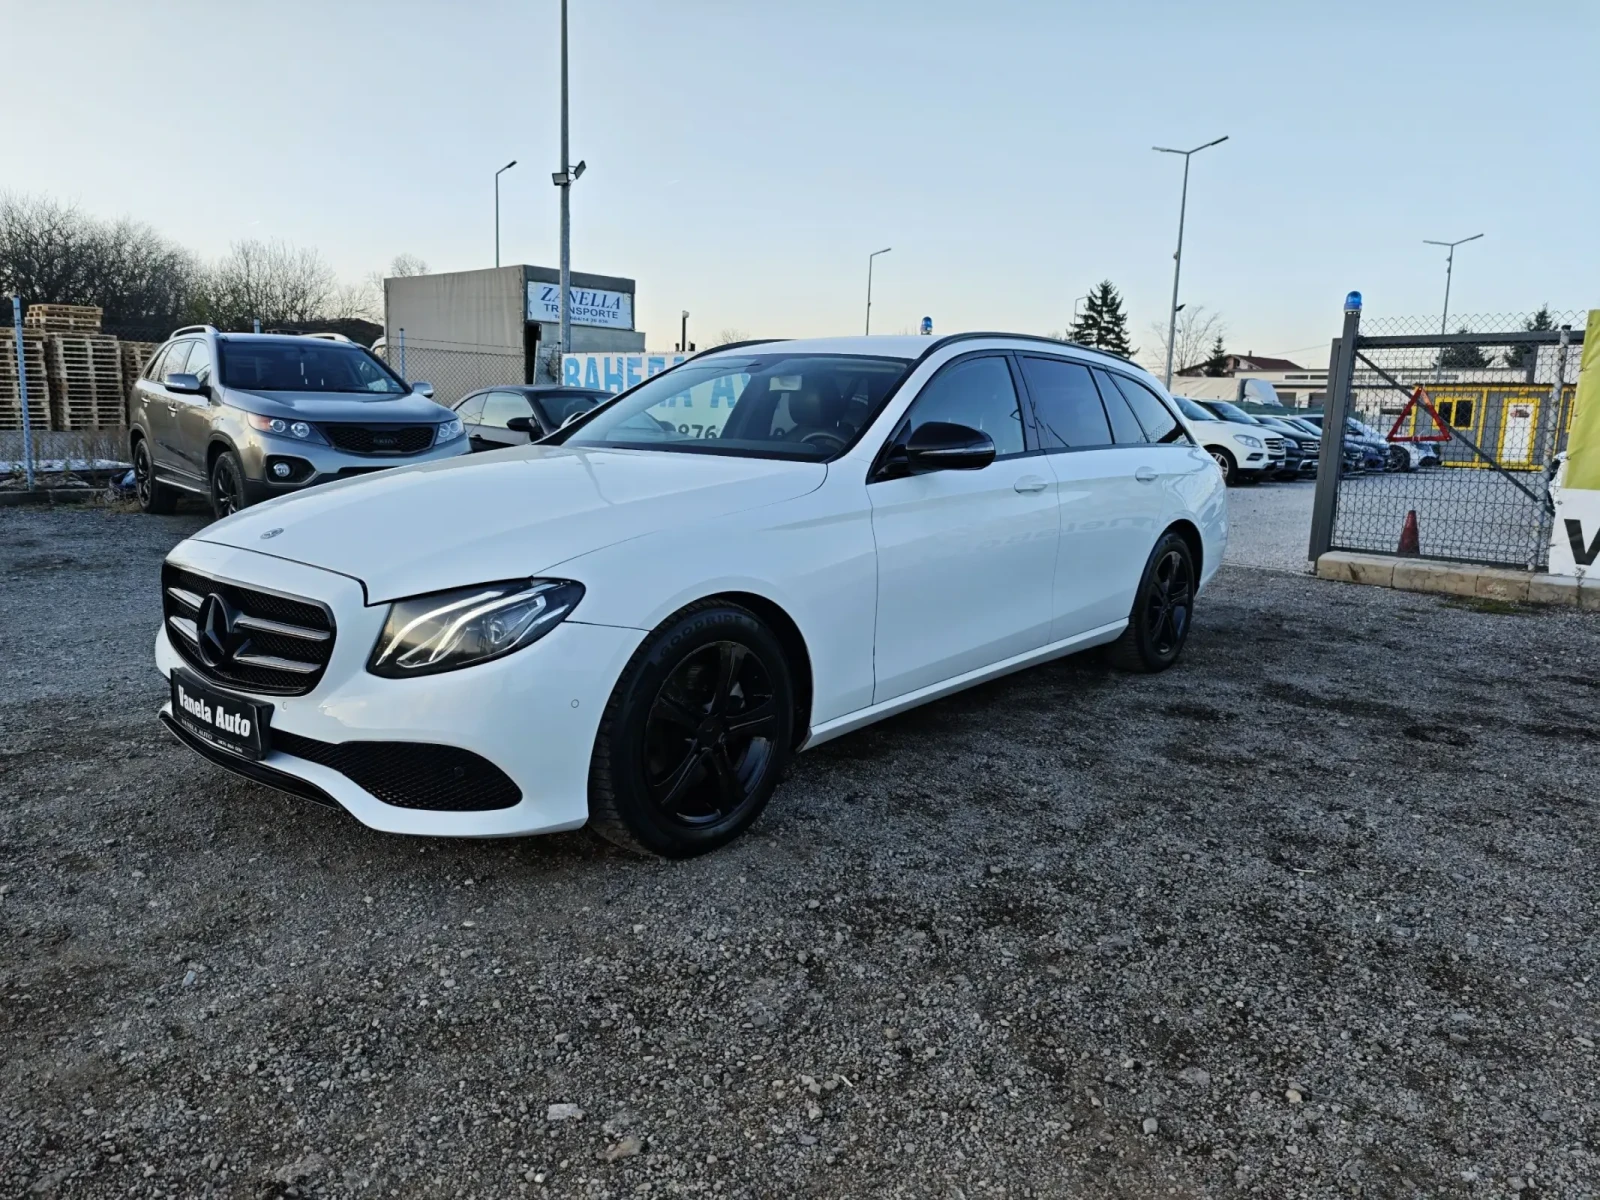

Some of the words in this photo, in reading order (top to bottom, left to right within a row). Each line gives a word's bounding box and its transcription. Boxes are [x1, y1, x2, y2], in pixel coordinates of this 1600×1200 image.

[543, 303, 619, 319] TRNSPORTE
[178, 684, 213, 724] Vanela
[215, 705, 251, 737] Auto
